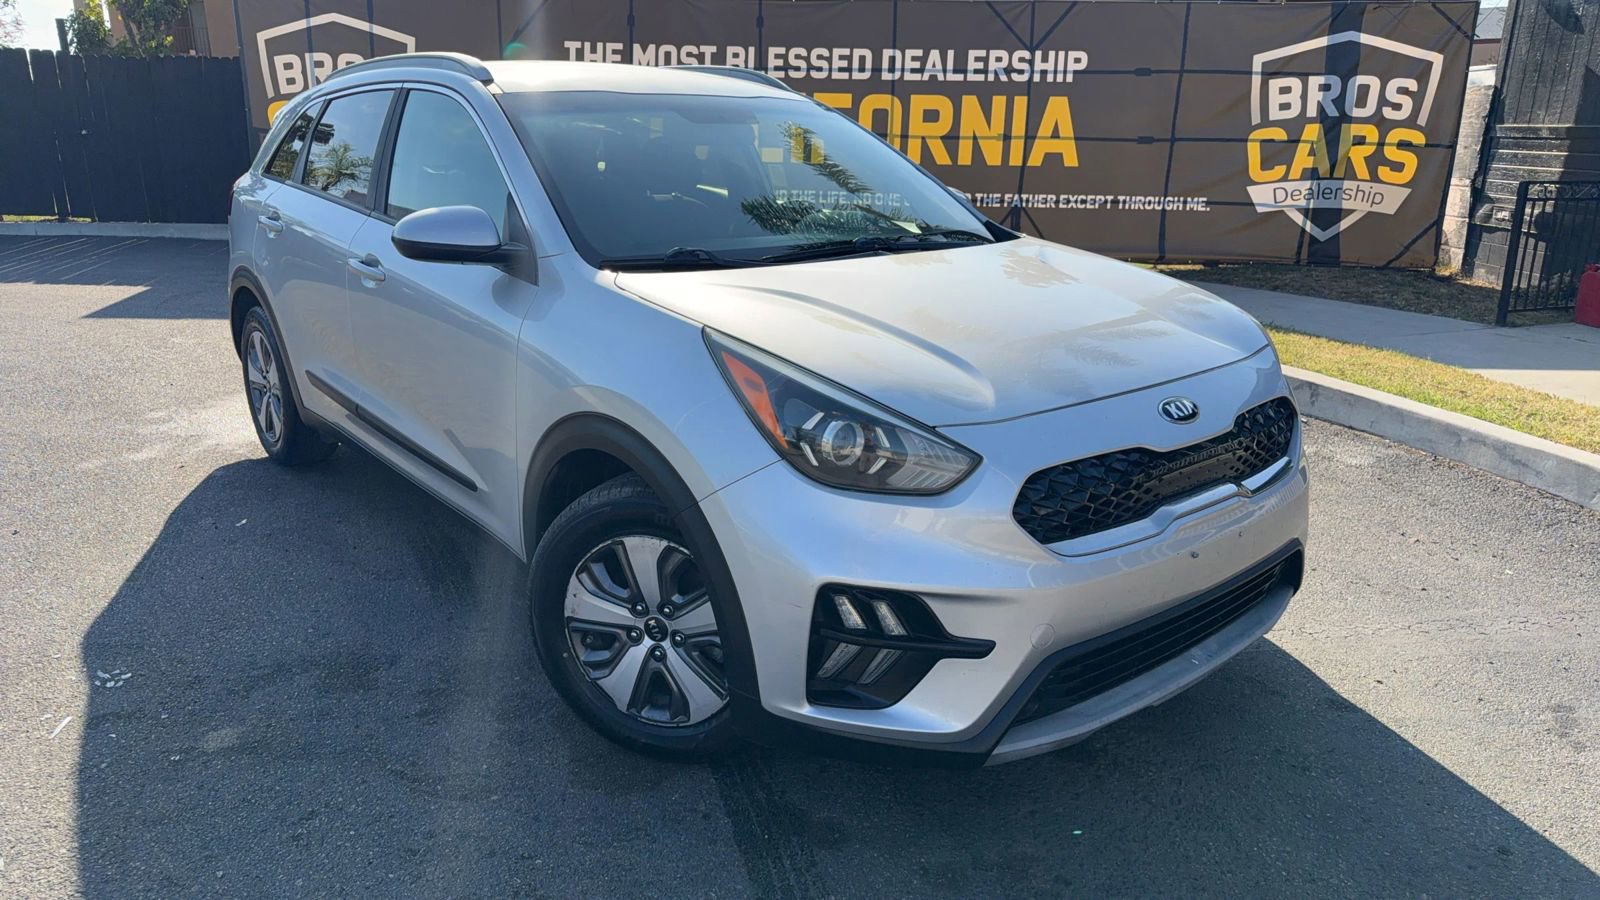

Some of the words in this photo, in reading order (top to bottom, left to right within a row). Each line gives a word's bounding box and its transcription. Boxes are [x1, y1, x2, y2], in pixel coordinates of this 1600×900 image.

[273, 52, 366, 95] BR
[564, 41, 623, 63] THE
[632, 43, 717, 67] MOST
[725, 46, 872, 80] BLESSED
[881, 48, 1088, 82] DEALERSHIP
[1268, 75, 1418, 121] BROS
[1247, 123, 1426, 184] CARS
[874, 192, 901, 206] ONE
[975, 193, 1001, 208] THE
[1004, 194, 1057, 208] FATHER
[1059, 195, 1114, 209] EXCEPT
[1117, 195, 1184, 211] THROUGH
[1186, 197, 1211, 211] ME.
[1273, 182, 1384, 208] Dealership
[1164, 399, 1198, 419] KIA
[647, 619, 662, 641] KIA
